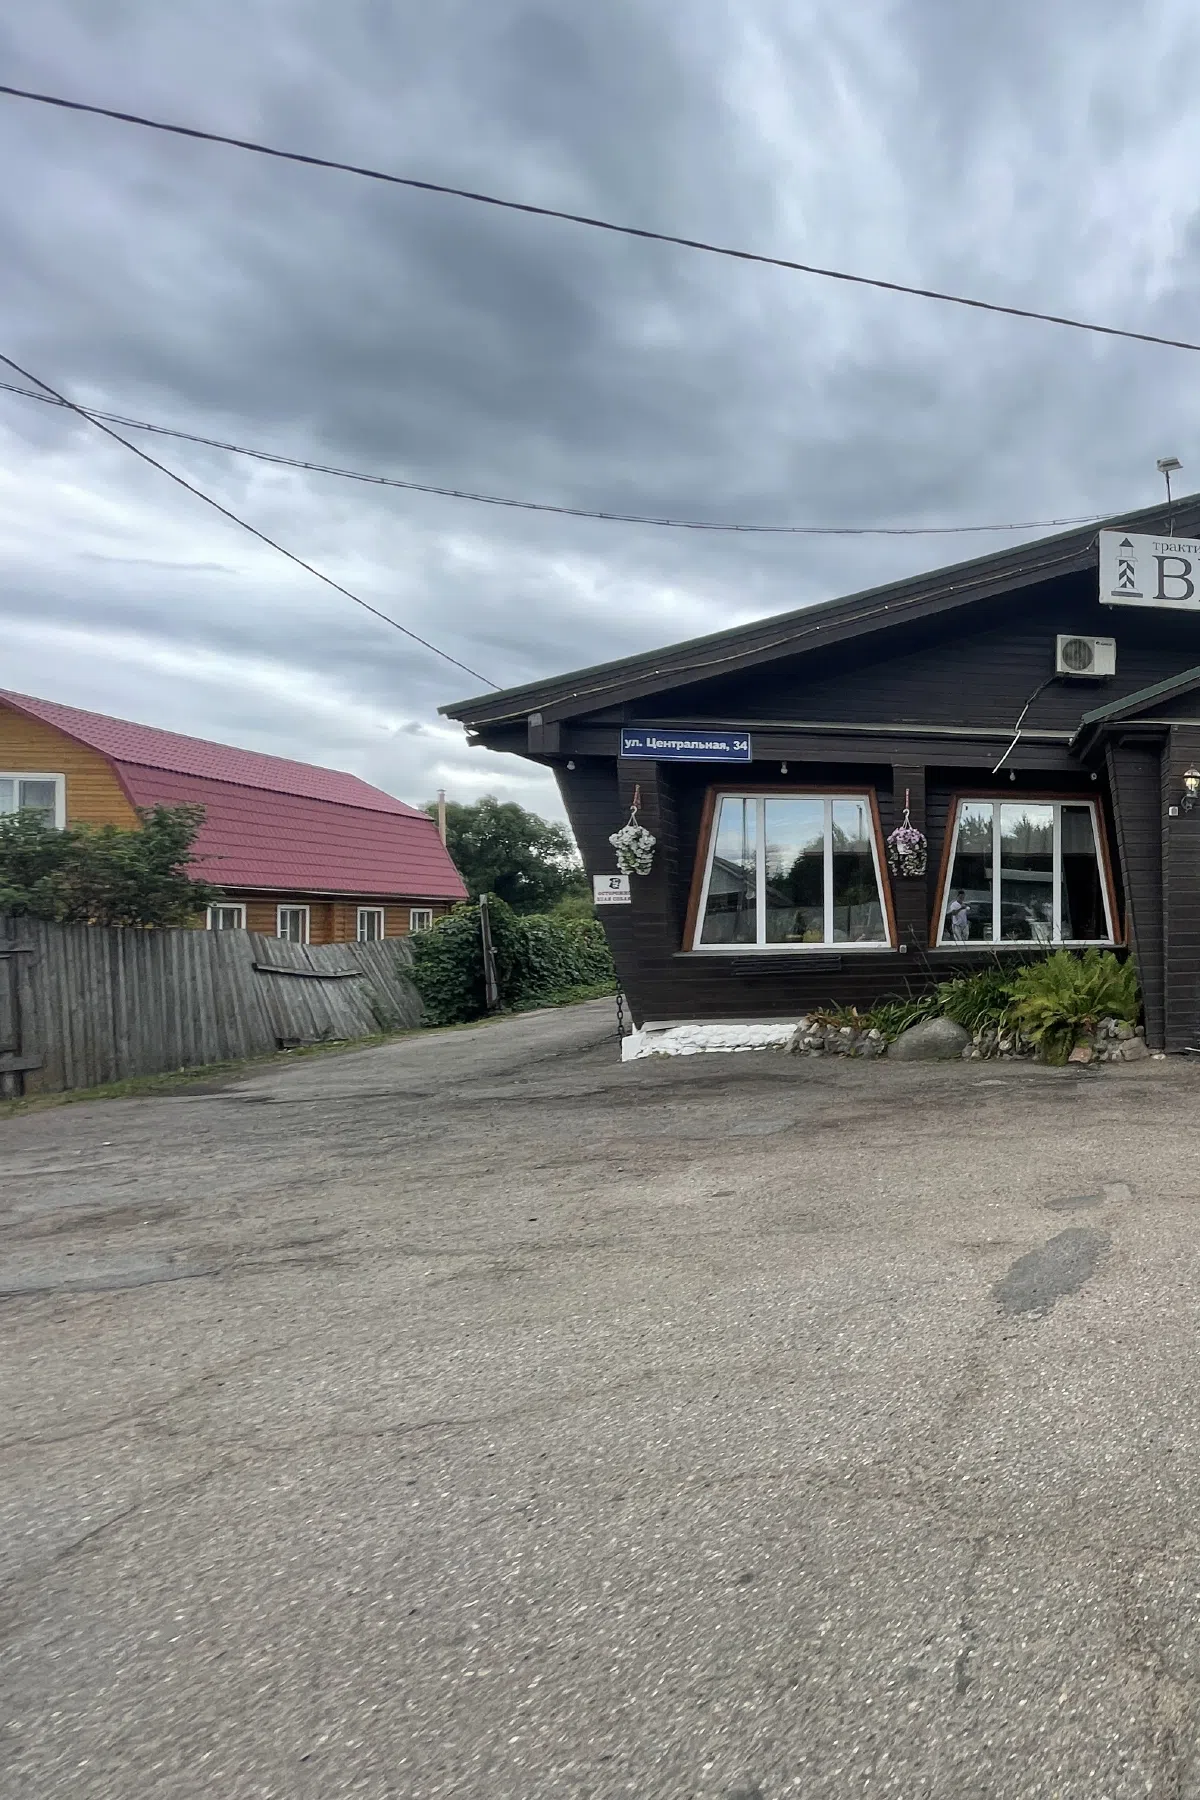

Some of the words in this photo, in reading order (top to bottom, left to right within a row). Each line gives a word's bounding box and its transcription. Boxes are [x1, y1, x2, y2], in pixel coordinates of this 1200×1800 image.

[624, 738, 643, 748] ул.
[646, 737, 730, 751] Центральная,
[733, 740, 748, 751] 34
